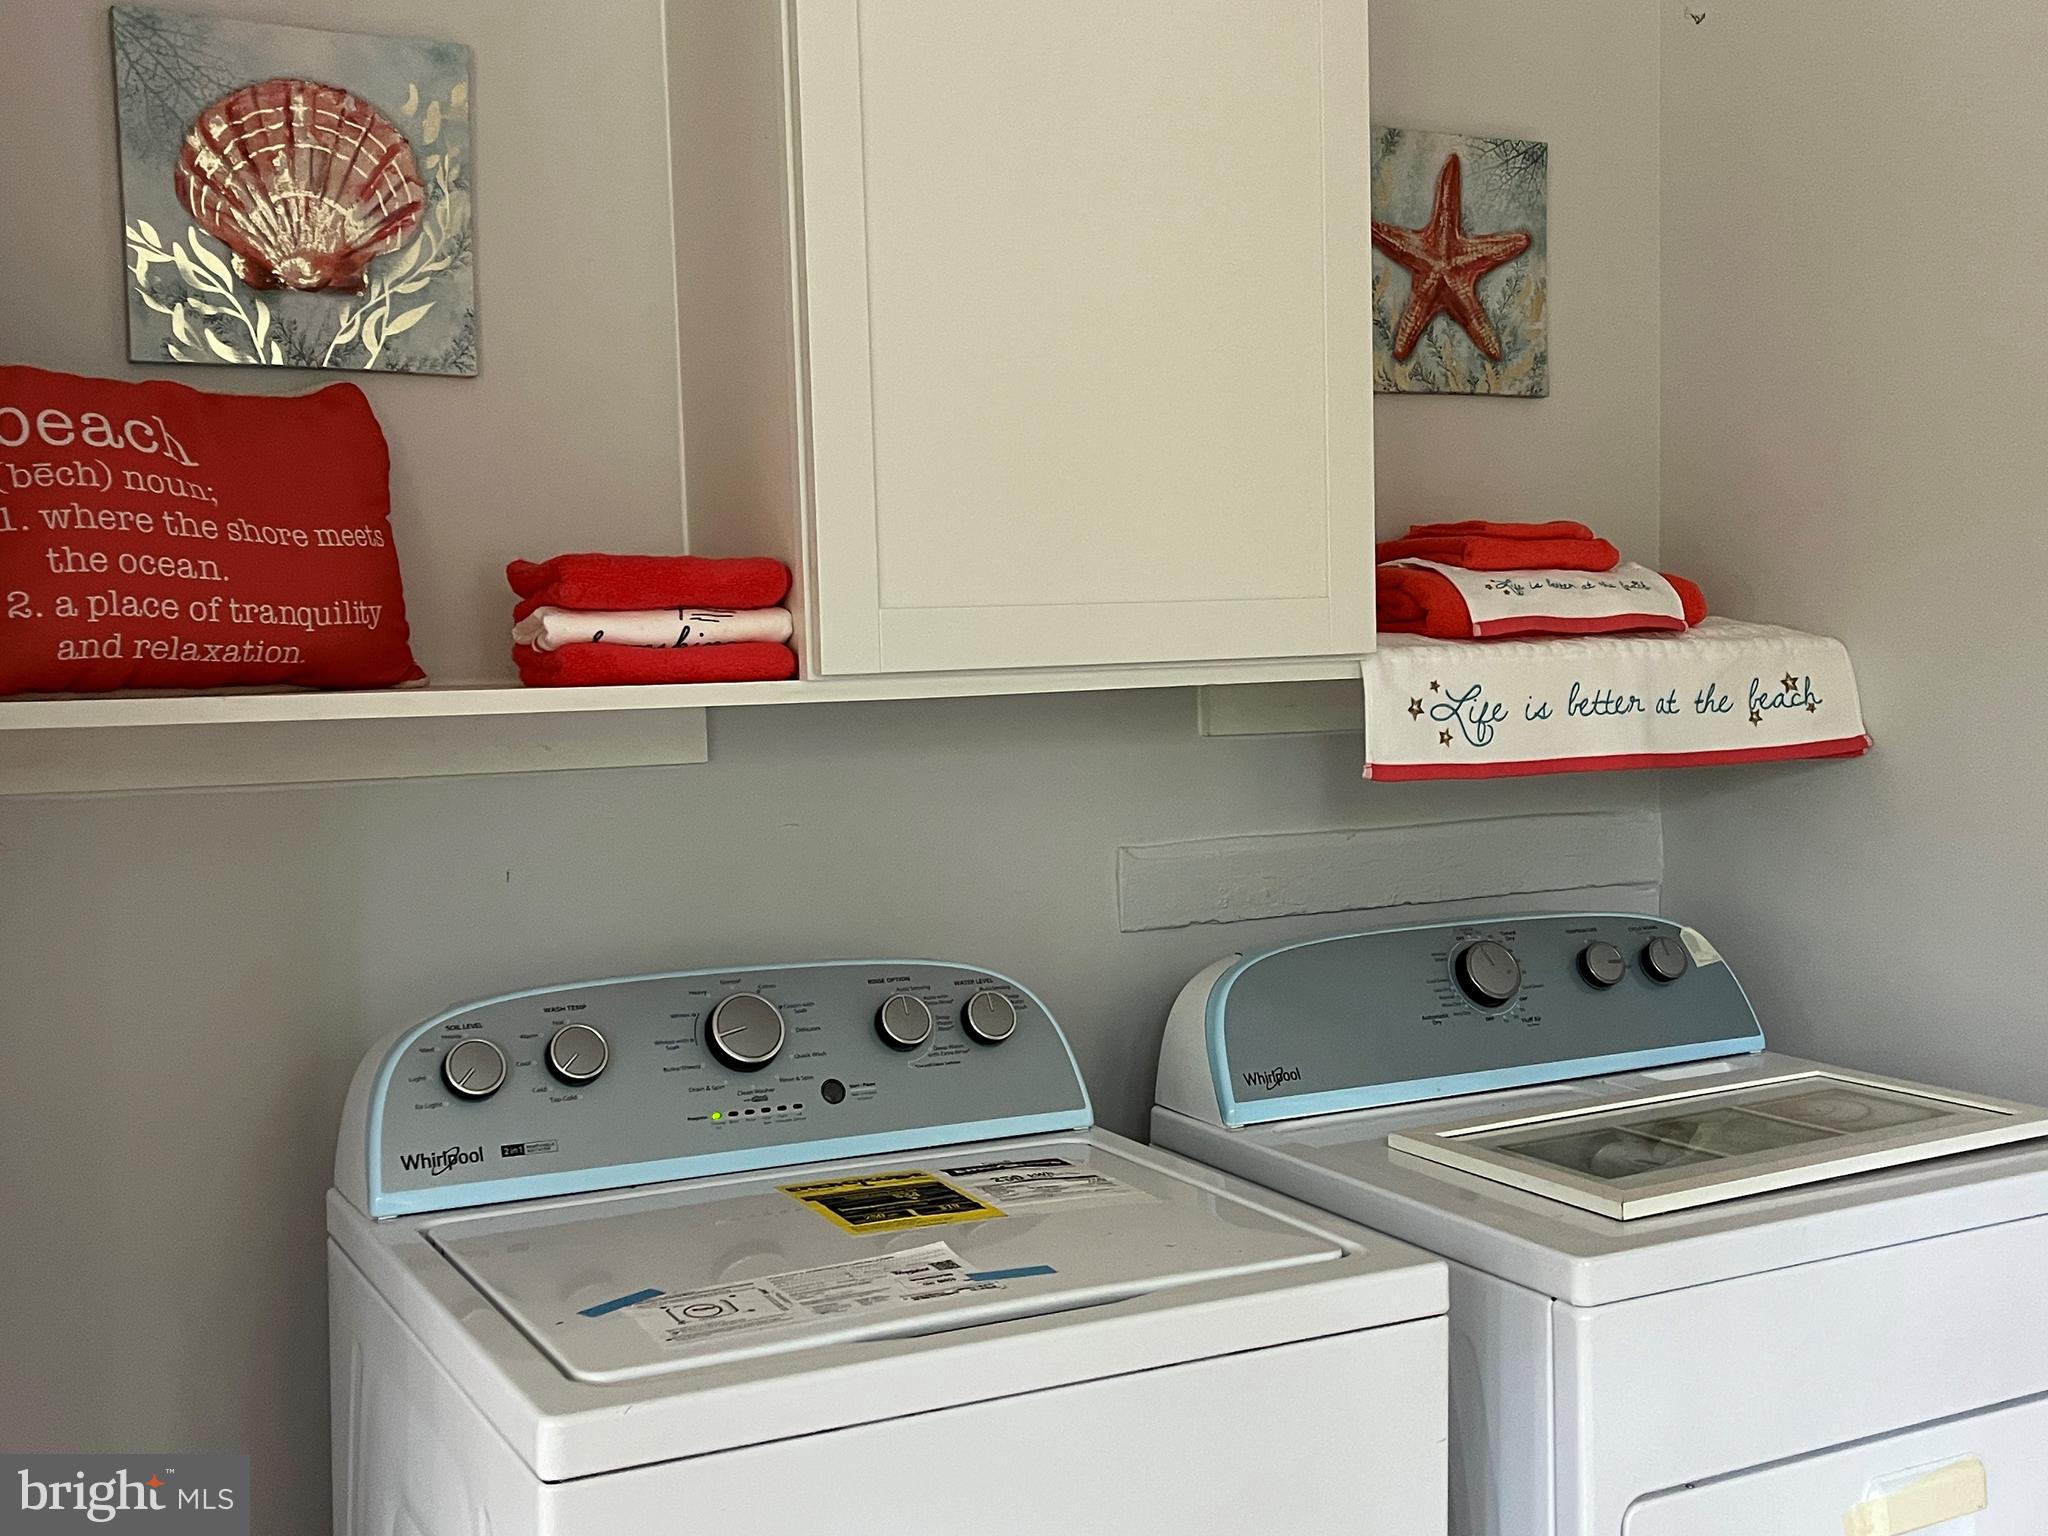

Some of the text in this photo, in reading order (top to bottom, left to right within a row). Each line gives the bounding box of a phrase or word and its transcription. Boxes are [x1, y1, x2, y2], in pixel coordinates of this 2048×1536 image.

[122, 470, 218, 507] noun;
[38, 503, 154, 533] where
[162, 511, 218, 539] the
[227, 518, 309, 547] shore
[314, 525, 385, 547] meets
[46, 546, 230, 582] the ocean.
[7, 590, 383, 632] 2. a place of tranquility
[57, 633, 124, 661] and
[1430, 675, 1824, 747] Life is better at the beach
[954, 977, 993, 986] WATER LEVEL
[463, 1022, 483, 1030] LEVEL
[1243, 1066, 1301, 1090] Whirlpool
[400, 1146, 484, 1176] Whirlpool
